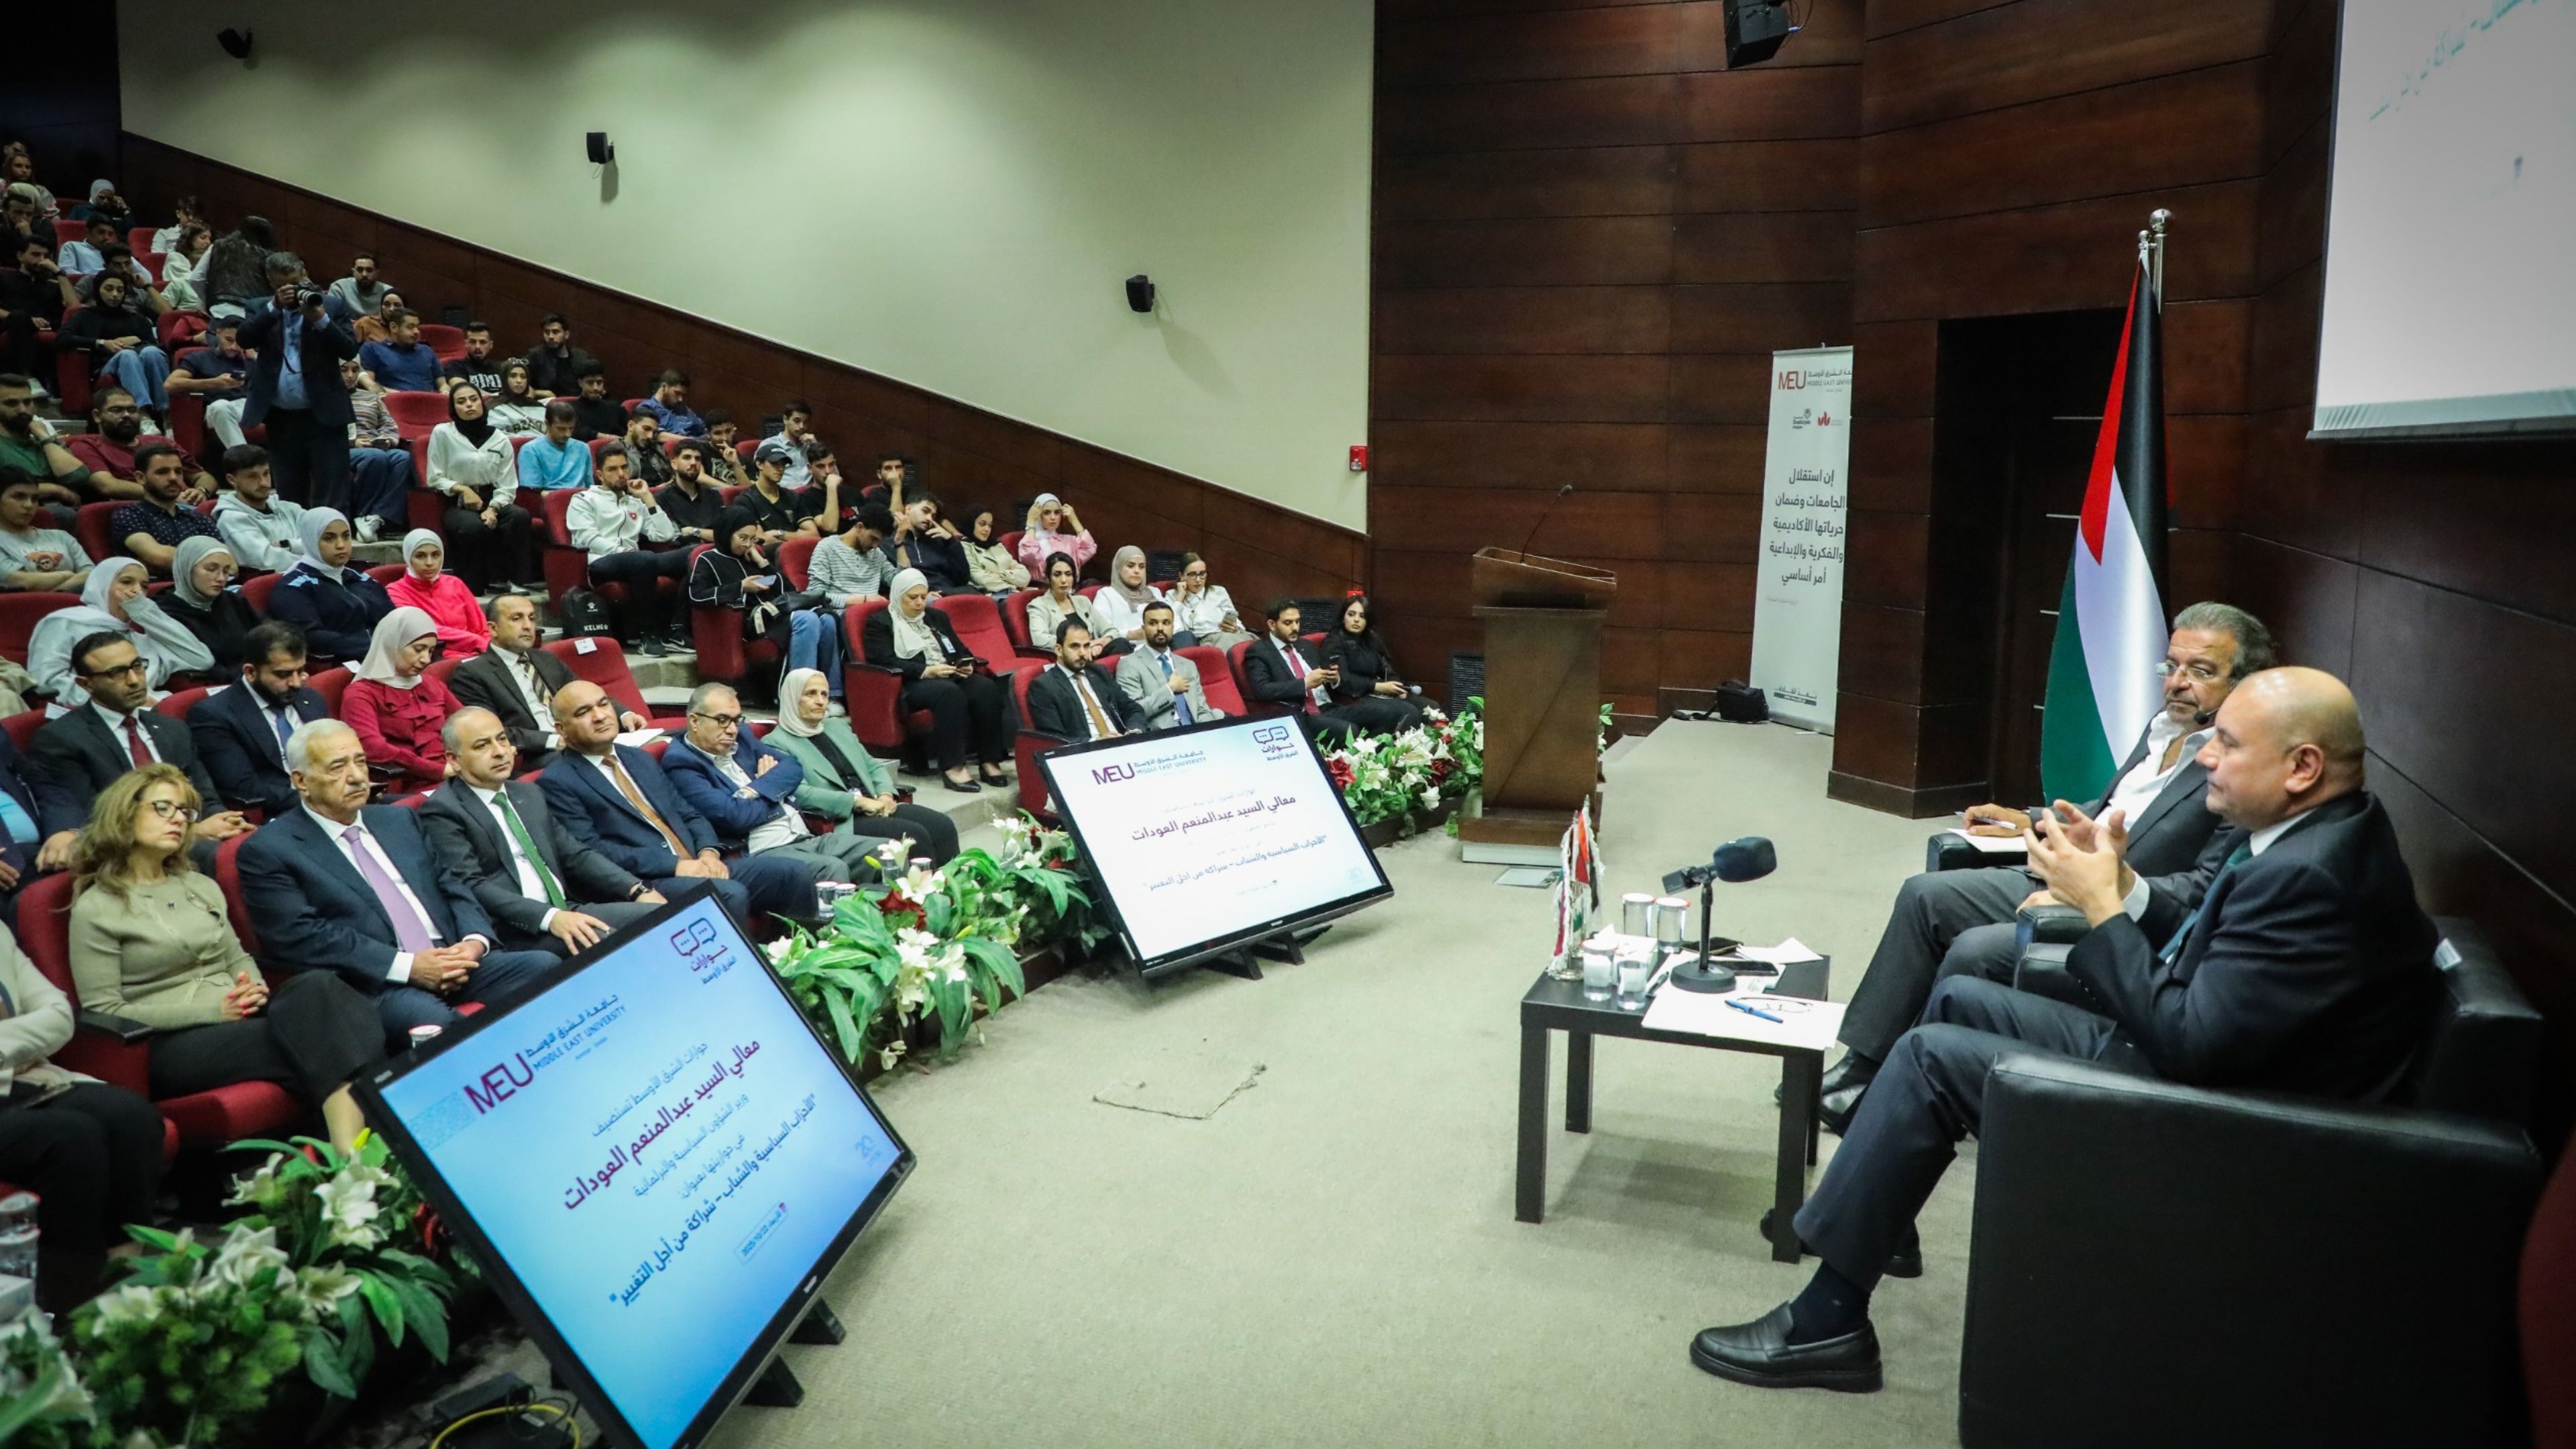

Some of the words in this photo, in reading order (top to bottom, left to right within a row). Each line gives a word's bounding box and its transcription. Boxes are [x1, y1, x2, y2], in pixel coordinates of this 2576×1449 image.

[1778, 370, 1807, 390] MEU
[1788, 468, 1823, 484] استقلال
[1823, 469, 1834, 487] إن
[1775, 492, 1805, 509] وضمان
[1806, 494, 1845, 512] الجامعات
[1773, 517, 1813, 533] الأكاديمية
[1815, 520, 1843, 537] حرياتها
[1770, 541, 1807, 560] والإبداعية
[1809, 545, 1843, 564] والفكرية
[1782, 565, 1813, 586] أساسي
[1813, 566, 1827, 586] أمر
[1261, 743, 1294, 753] حوارات
[1174, 757, 1207, 767] UNIVERSITY
[1091, 763, 1135, 785] MEU
[1237, 800, 1265, 818] السيد
[1267, 796, 1296, 814] معالي
[1132, 820, 1179, 841] العودات
[1181, 810, 1234, 835] عبدالمنعم
[691, 945, 729, 971] حوارات
[533, 1047, 564, 1071] MIDDLE
[564, 1033, 584, 1051] EAST
[584, 1005, 626, 1037] UNIVERSITY
[729, 1040, 760, 1079] معالي
[464, 1053, 534, 1115] MEU
[694, 1061, 729, 1100] السيد
[592, 1099, 633, 1136] تستضيف
[631, 1097, 694, 1166] عبدالمنعم
[754, 1121, 792, 1162] السياسية
[673, 1126, 707, 1160] السياسية
[565, 1145, 629, 1210] العودات
[633, 1159, 677, 1196] والبرلمانية
[722, 1160, 759, 1198] والشباب
[685, 1199, 716, 1231] شراكة
[674, 1231, 689, 1252] من
[653, 1236, 674, 1271] أجل
